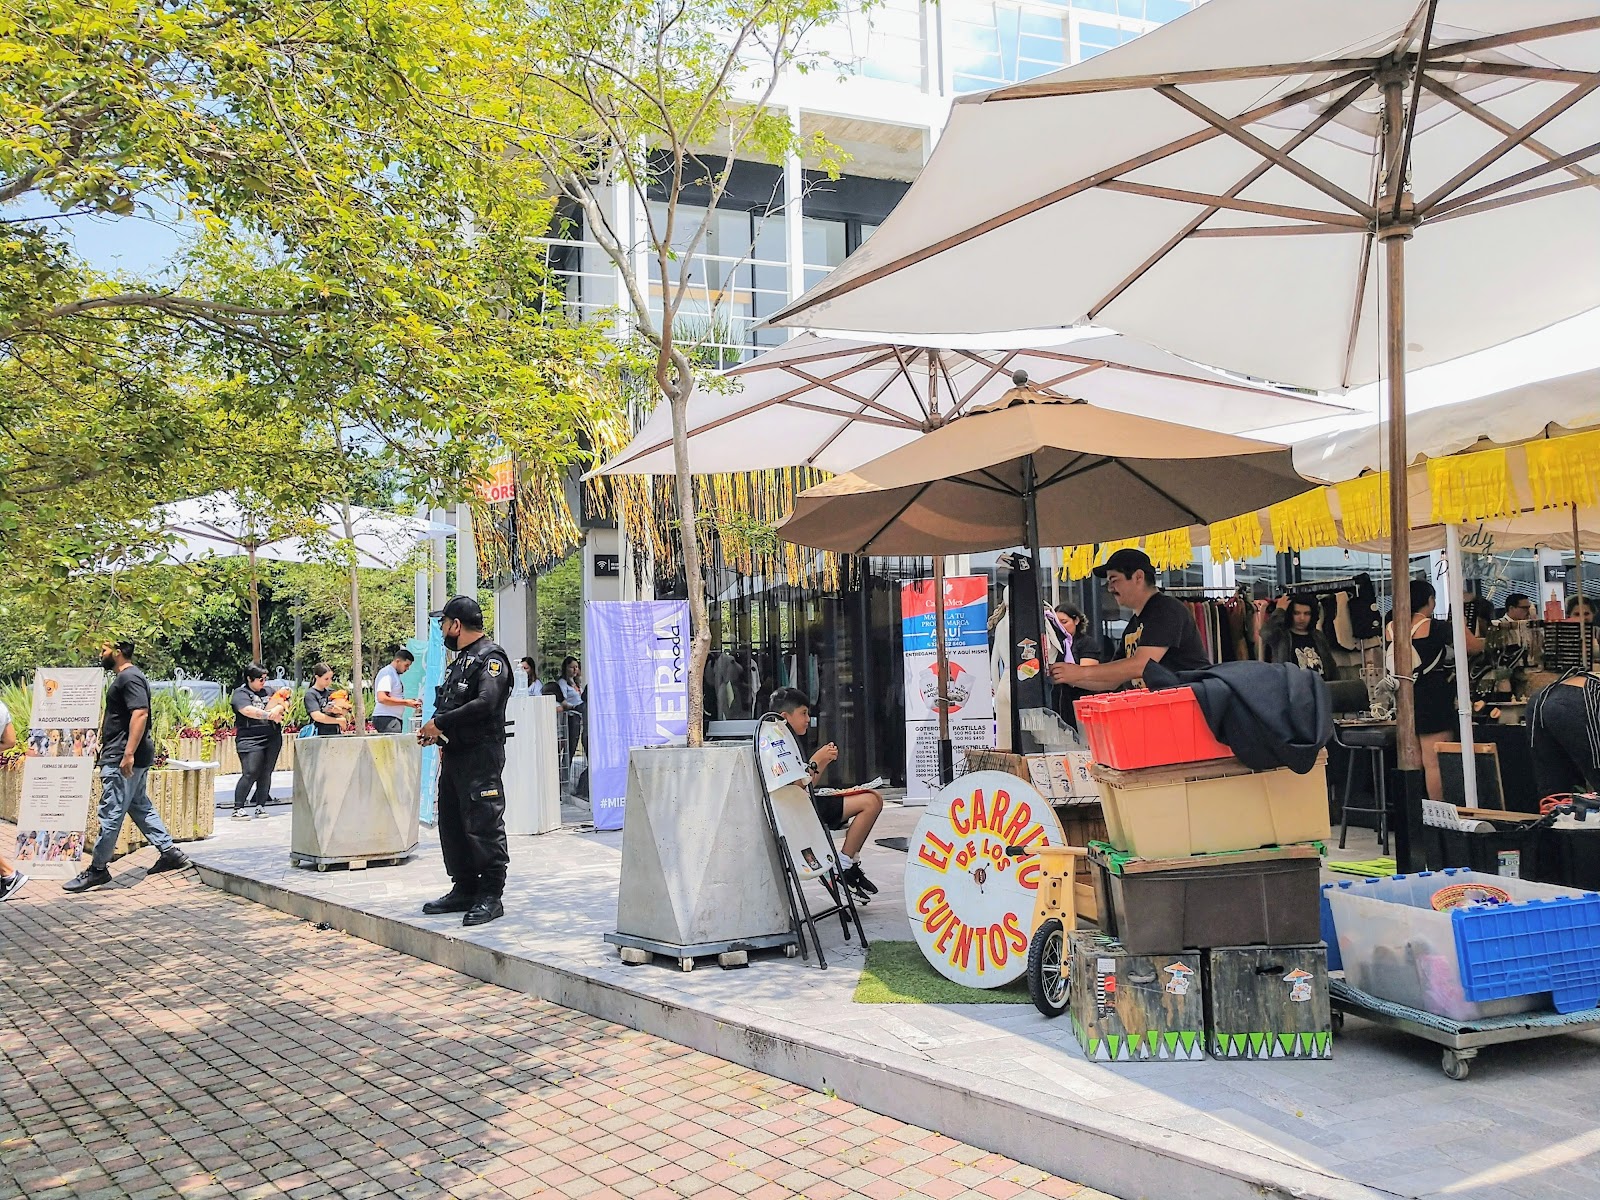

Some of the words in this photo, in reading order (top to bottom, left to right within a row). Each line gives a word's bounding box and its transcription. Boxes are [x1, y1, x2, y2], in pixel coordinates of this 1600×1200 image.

[930, 626, 961, 638] AUÍ
[657, 625, 682, 683] moda
[918, 830, 954, 870] EL
[955, 840, 977, 867] DE
[983, 838, 1011, 872] LOS
[918, 887, 1028, 972] CUENTOS
